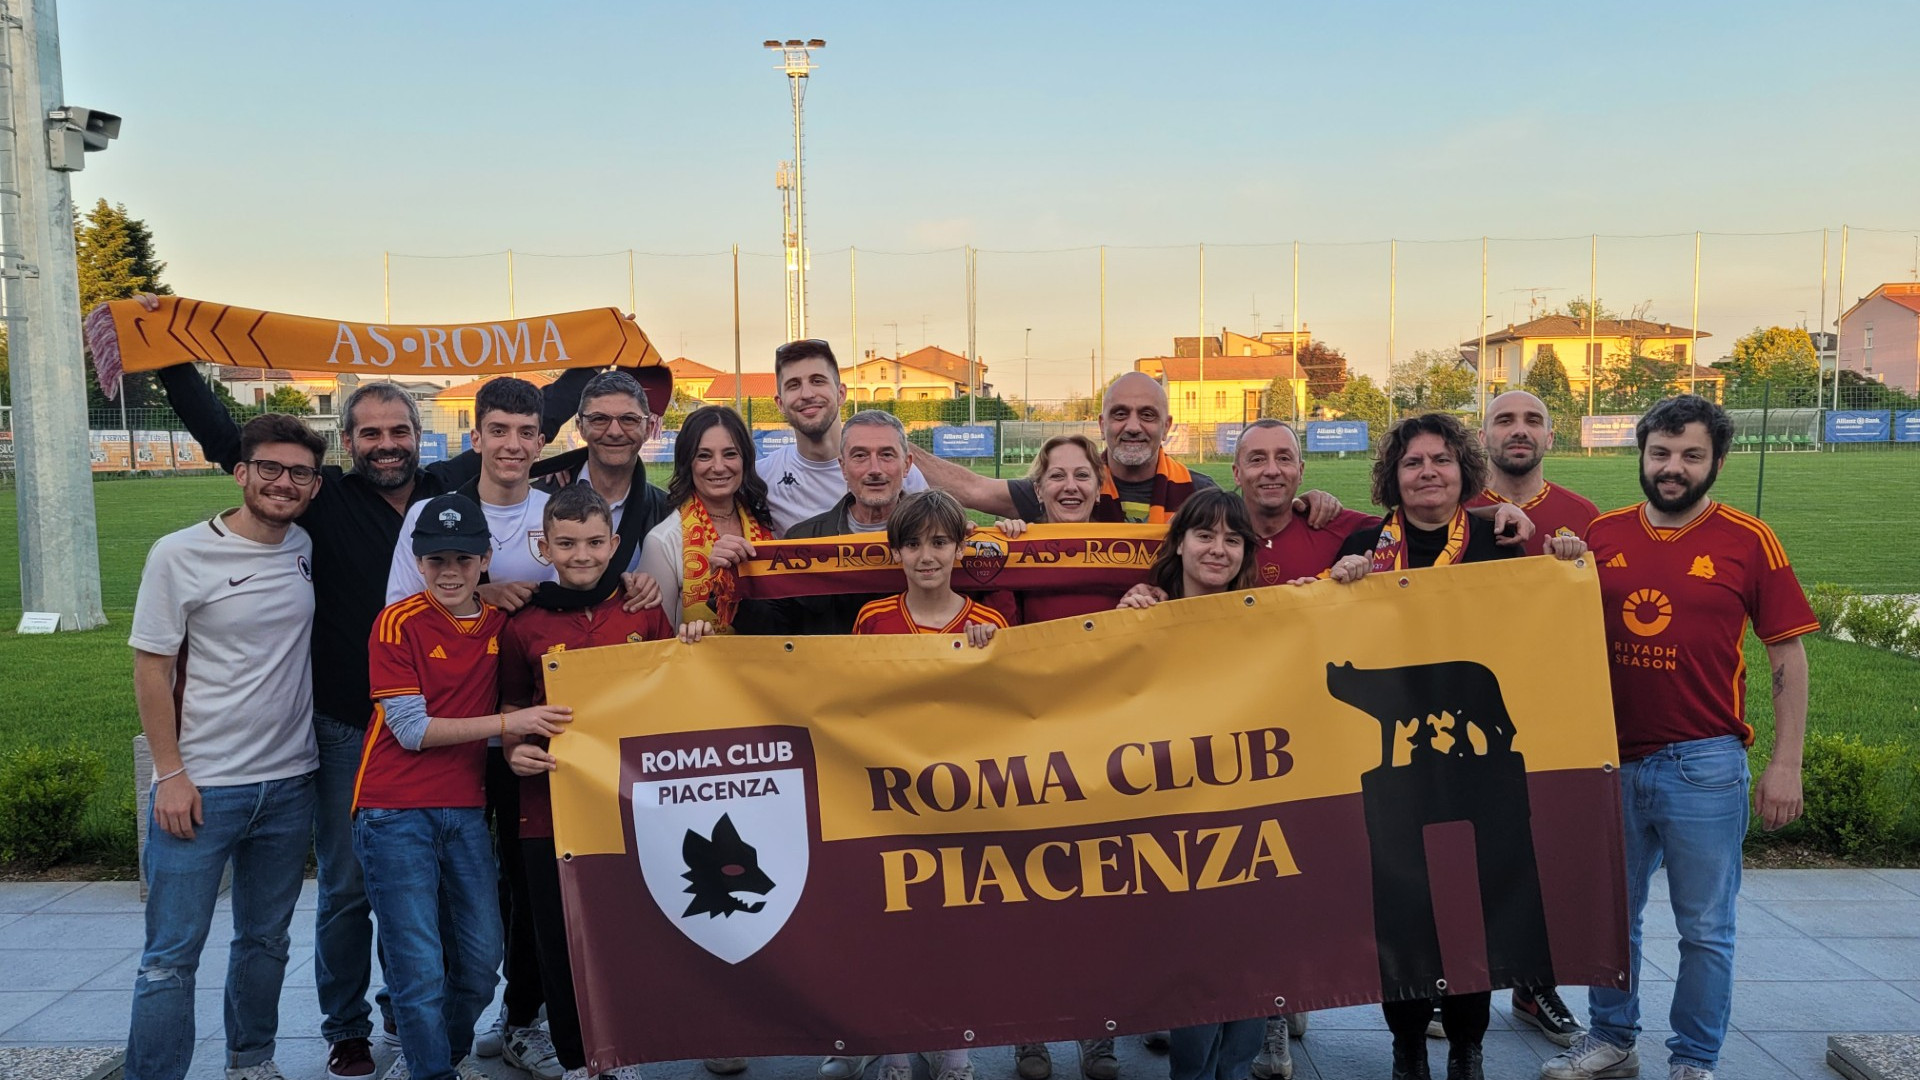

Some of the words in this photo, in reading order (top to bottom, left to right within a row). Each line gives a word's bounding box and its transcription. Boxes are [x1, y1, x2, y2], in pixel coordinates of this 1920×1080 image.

[966, 560, 1001, 568] ROMA
[1083, 540, 1164, 565] ROM
[1614, 641, 1676, 658] RIYADH
[1615, 653, 1676, 670] SEASON
[641, 747, 722, 774] ROMA
[727, 741, 794, 766] CLUB
[865, 750, 1088, 816] ROMA
[1106, 727, 1294, 796] CLUB
[658, 777, 780, 806] PIACENZA
[879, 818, 1302, 912] PIACENZA
